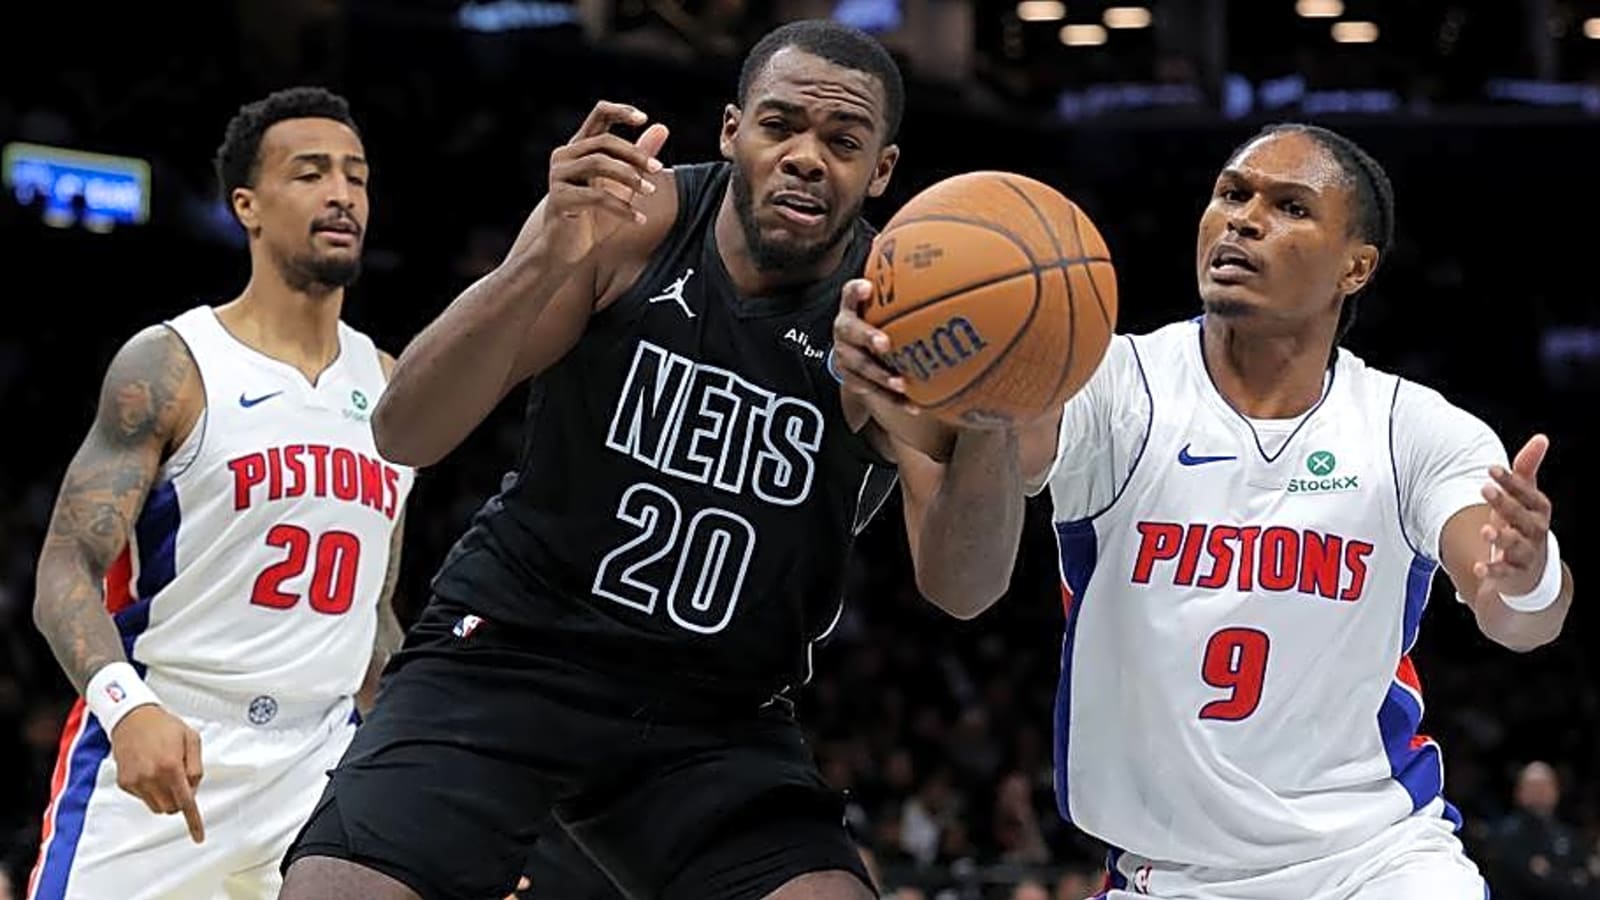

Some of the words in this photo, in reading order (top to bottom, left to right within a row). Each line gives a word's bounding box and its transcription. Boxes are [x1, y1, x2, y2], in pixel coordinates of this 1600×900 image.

[784, 328, 809, 346] Ali
[605, 340, 824, 506] NETS
[228, 444, 399, 521] PISTONS
[250, 523, 361, 615] 20
[592, 482, 756, 634] 20
[1131, 522, 1374, 602] PISTONS
[1199, 627, 1270, 722] 9
